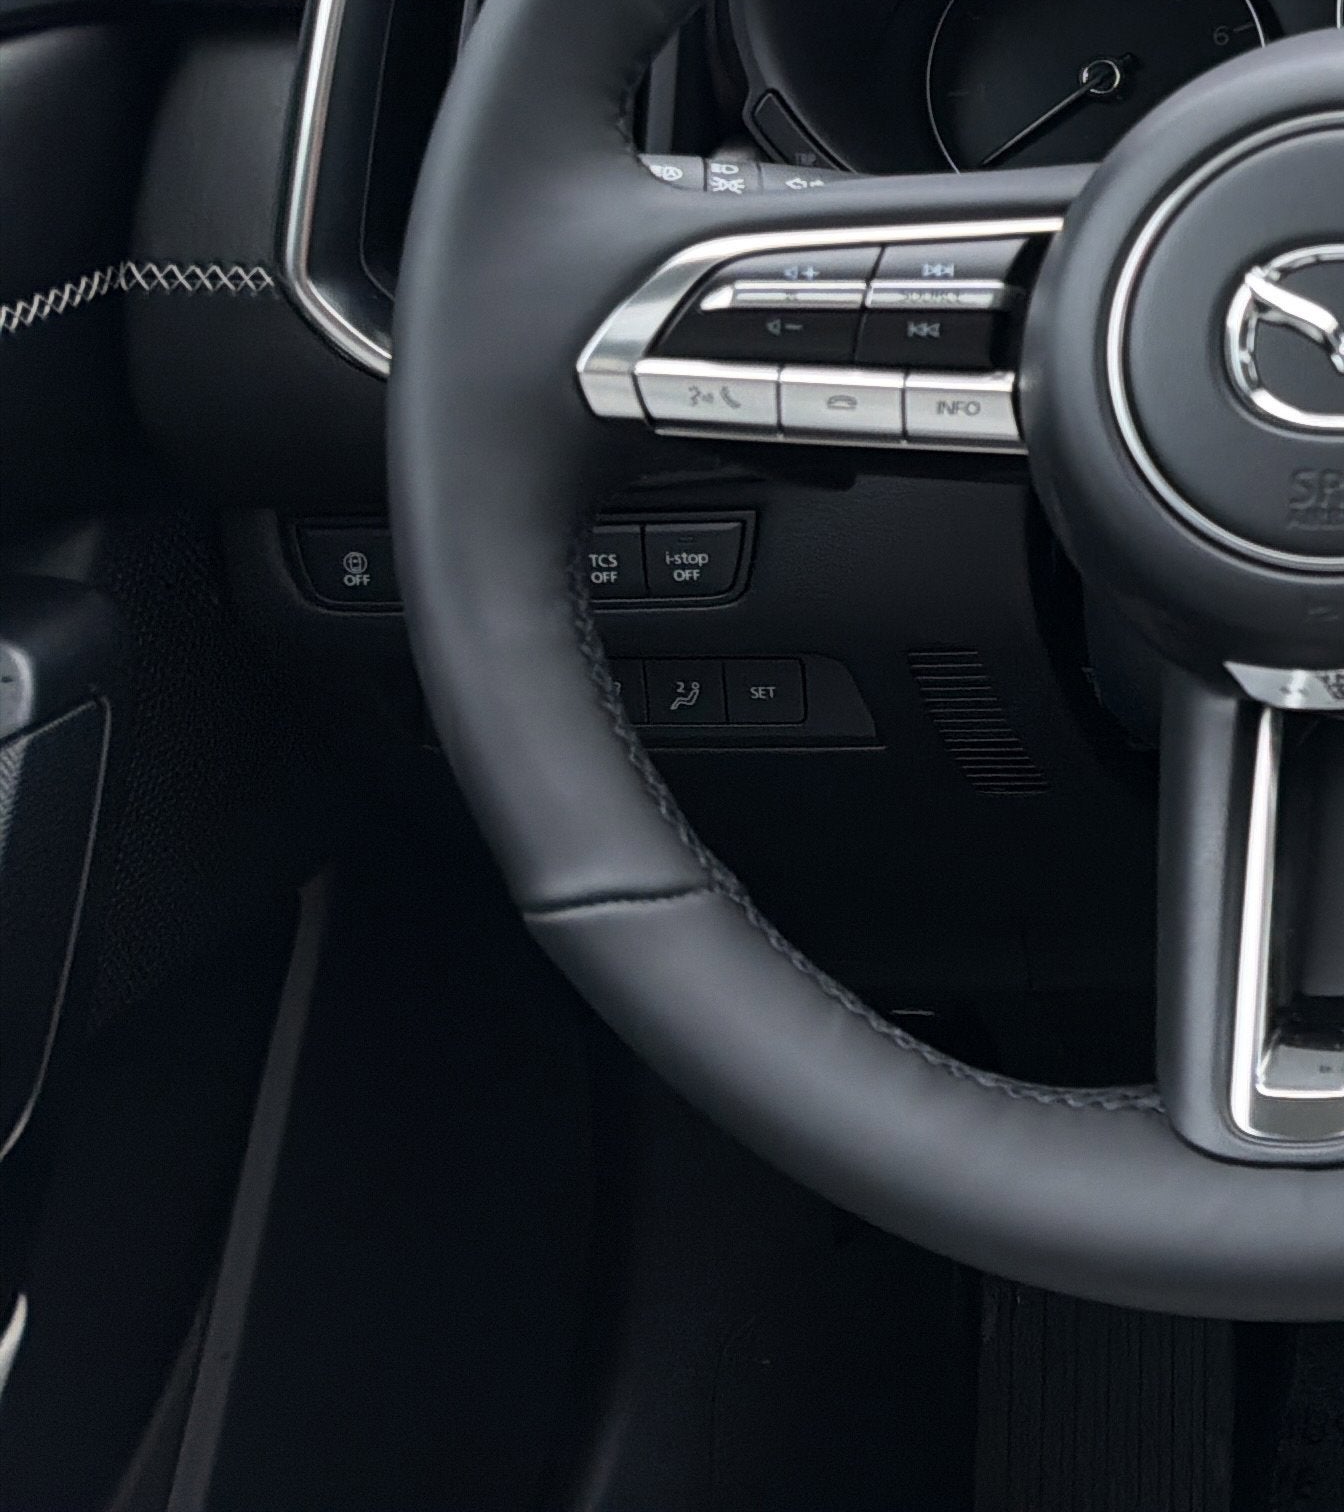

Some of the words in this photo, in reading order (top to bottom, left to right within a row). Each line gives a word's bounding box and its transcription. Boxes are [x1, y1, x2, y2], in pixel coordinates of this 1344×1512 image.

[1213, 24, 1230, 46] 6
[936, 400, 981, 417] INFO
[588, 553, 619, 568] TCS
[664, 551, 709, 568] i-stop
[343, 574, 371, 587] OFF
[590, 570, 618, 584] OFF
[673, 569, 700, 582] OFF
[750, 686, 776, 699] SET
